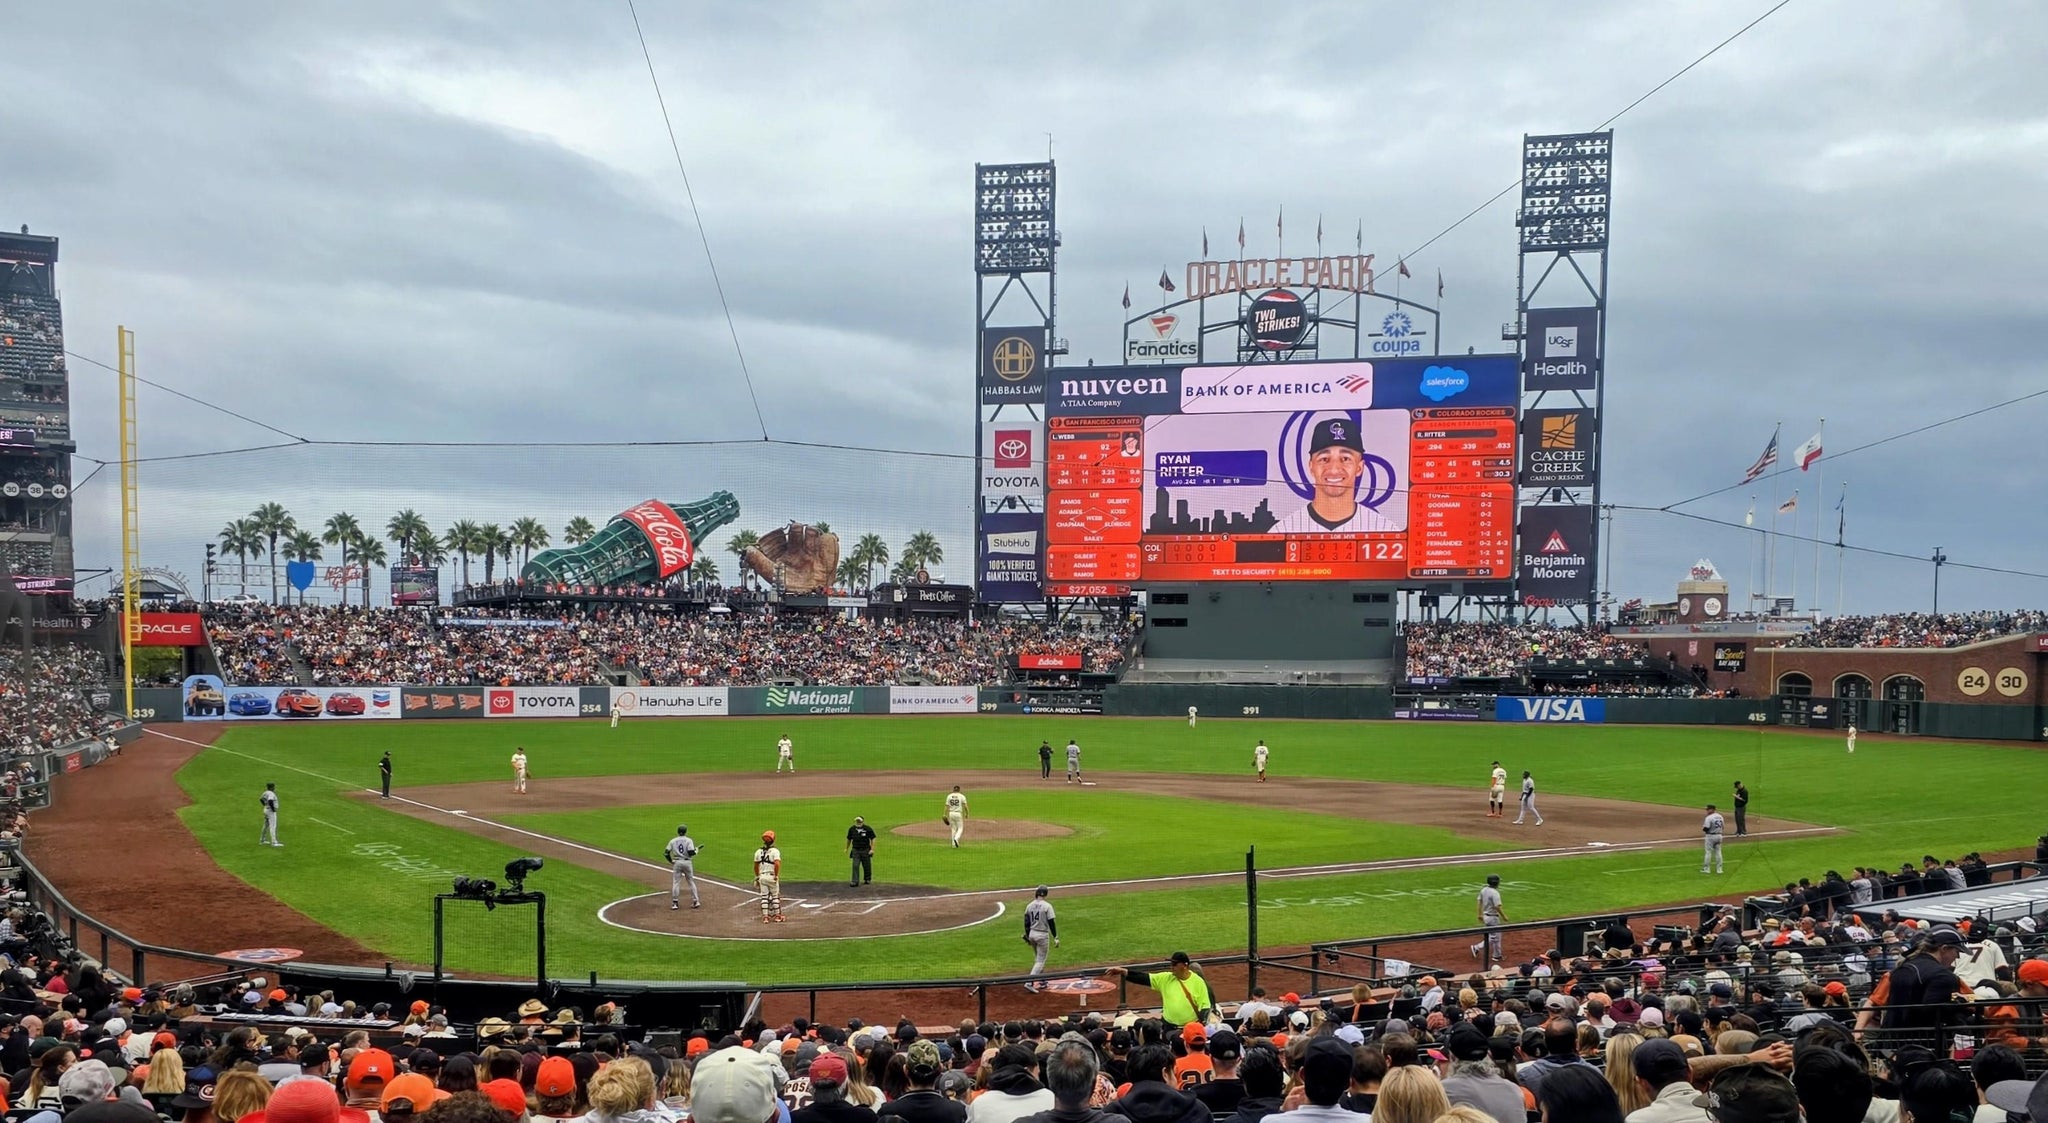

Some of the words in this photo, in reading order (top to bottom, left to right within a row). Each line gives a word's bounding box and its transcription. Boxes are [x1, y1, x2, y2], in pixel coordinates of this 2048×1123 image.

[1186, 258, 1292, 300] ORACLE
[1302, 254, 1375, 295] PARK
[1254, 309, 1276, 324] TWO
[1257, 316, 1300, 333] STRIKES!
[1373, 338, 1420, 354] coupa
[1548, 336, 1574, 348] UCSF
[1128, 340, 1196, 356] Fanatics
[1534, 362, 1587, 376] Health
[1061, 376, 1168, 396] nuveen
[1426, 376, 1464, 387] salesforce
[985, 386, 1020, 395] HABBAS
[1023, 385, 1042, 394] LAW
[1186, 386, 1228, 397] BANK
[1234, 384, 1254, 396] OF
[1258, 382, 1332, 395] AMERICA
[1088, 400, 1122, 408] Company
[1160, 455, 1190, 464] RYAN
[1531, 451, 1585, 461] CACHE
[1160, 466, 1204, 477] RITTER
[1532, 462, 1583, 472] CREEK
[985, 477, 1040, 487] TOYOTA
[993, 538, 1030, 547] StubHub
[1290, 543, 1296, 551] 0
[1362, 543, 1370, 559] 1
[1376, 543, 1387, 559] 2
[1391, 543, 1403, 559] 2
[1290, 553, 1296, 561] 2
[1524, 554, 1585, 568] Benjamin
[989, 560, 1006, 570] 100%
[1007, 560, 1035, 570] VERIFIED
[986, 572, 1009, 581] GIANTS
[1011, 572, 1037, 581] TICKETS
[1533, 567, 1576, 578] Moore
[936, 590, 955, 602] Coffee
[1069, 586, 1107, 595] $27,052
[32, 617, 74, 628] Health
[1964, 676, 1985, 688] 24
[2002, 676, 2022, 688] 30
[519, 697, 575, 708] TOYOTA
[640, 696, 694, 706] Hanwha
[698, 696, 722, 706] Life
[787, 690, 853, 706] National
[133, 709, 155, 718] 339
[581, 704, 601, 713] 354
[1243, 706, 1259, 715] 391
[1518, 699, 1585, 721] VISA
[1748, 713, 1766, 722] 415
[678, 844, 684, 854] 8
[1031, 911, 1040, 922] 14
